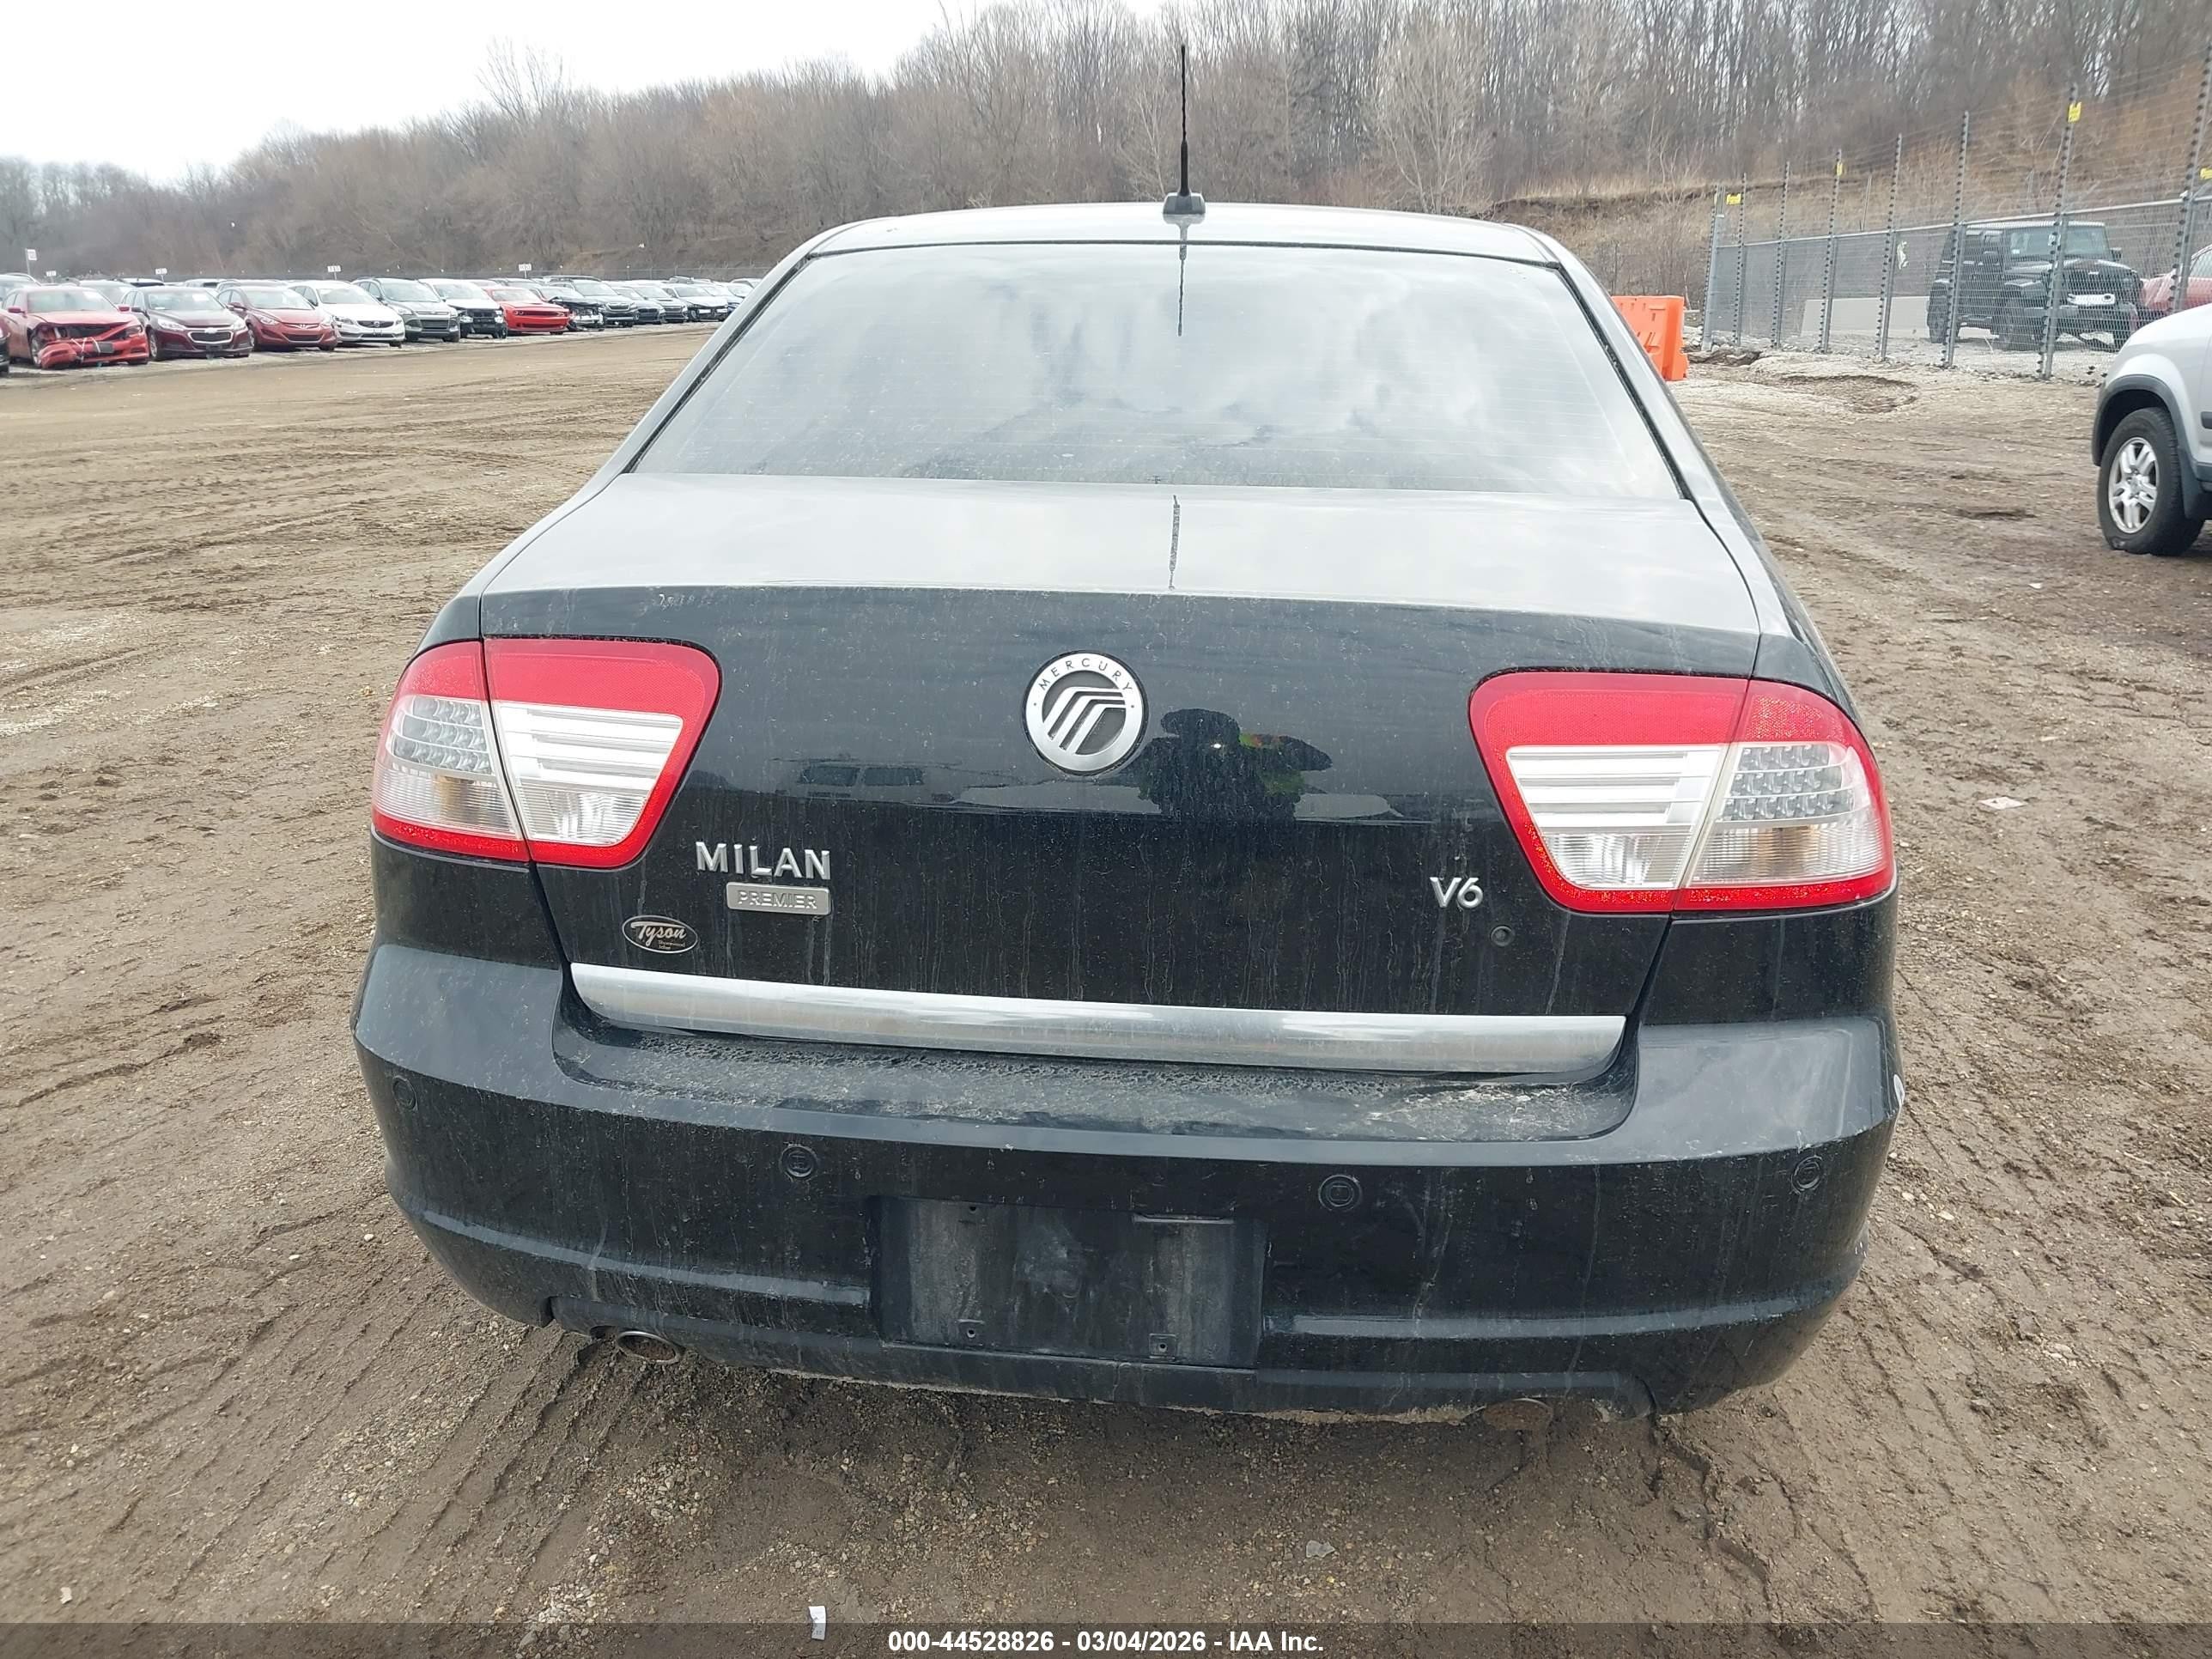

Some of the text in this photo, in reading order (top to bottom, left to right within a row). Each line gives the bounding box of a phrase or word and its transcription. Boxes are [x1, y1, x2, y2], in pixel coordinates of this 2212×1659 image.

[1037, 657, 1133, 691] MERCURY
[695, 841, 831, 881] MILAN
[737, 890, 817, 910] PREMIER
[1429, 876, 1484, 909] V6
[630, 921, 687, 947] Tyson
